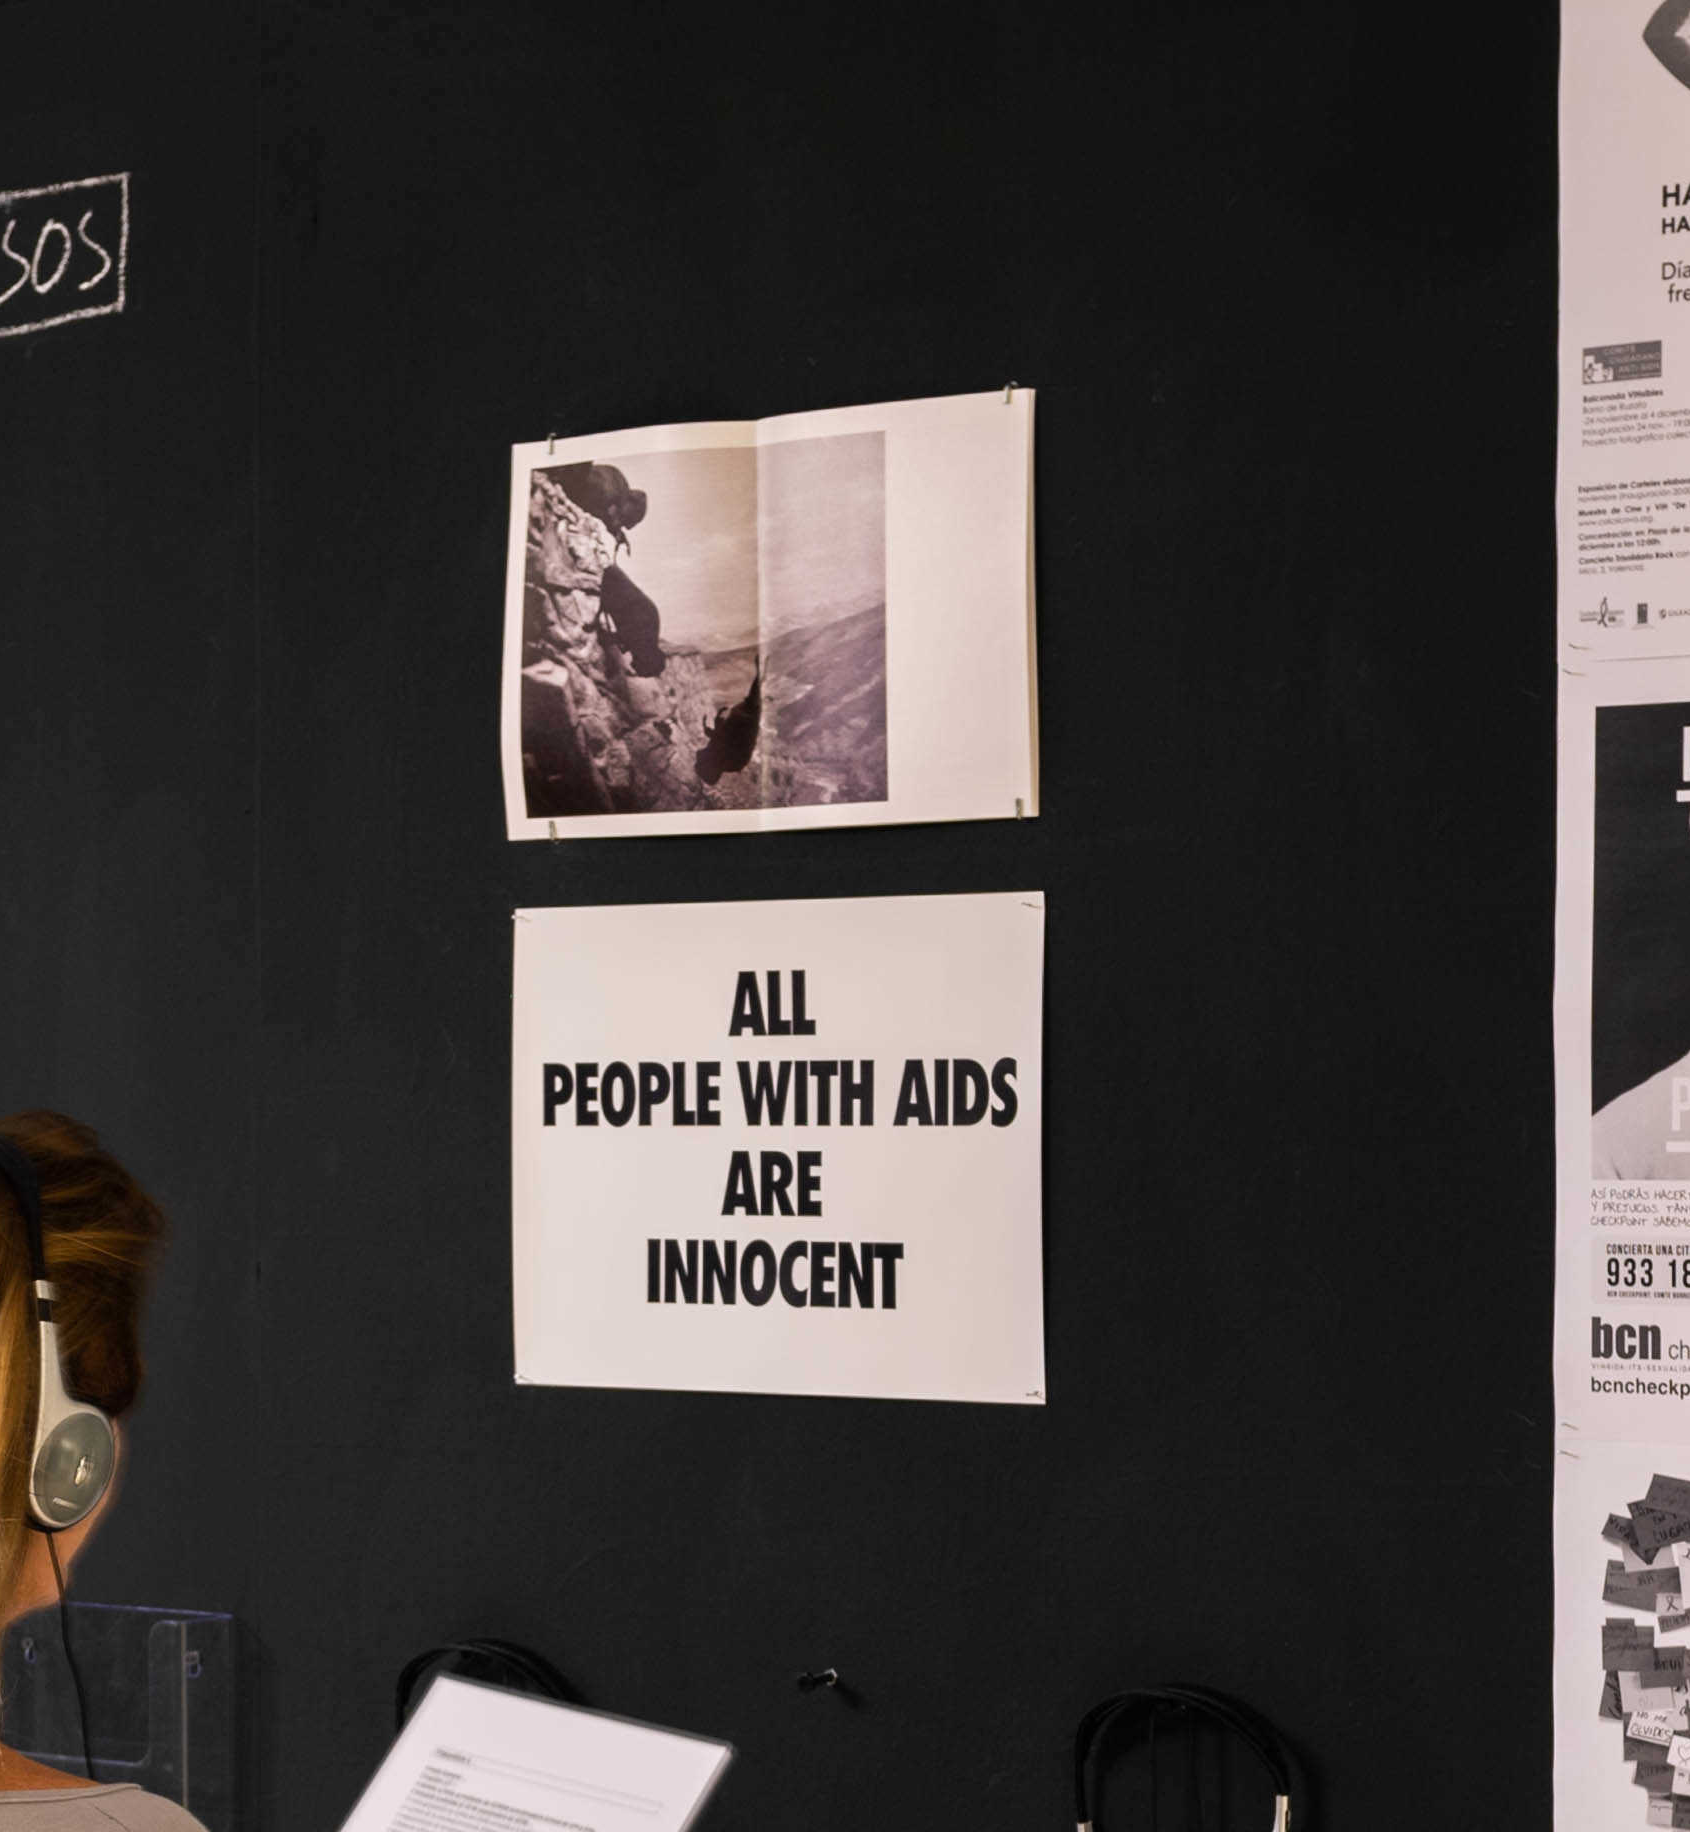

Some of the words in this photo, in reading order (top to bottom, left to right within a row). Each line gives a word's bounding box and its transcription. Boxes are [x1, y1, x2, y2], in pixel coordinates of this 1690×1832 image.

[728, 969, 816, 1036] ALL
[542, 1061, 721, 1127] PEOPLE
[736, 1060, 874, 1127] WITH
[892, 1057, 1018, 1127] AIDS
[721, 1151, 822, 1217] ARE
[647, 1239, 904, 1310] INNOCENT
[1607, 1258, 1653, 1287] 933
[1591, 1316, 1661, 1360] bcn
